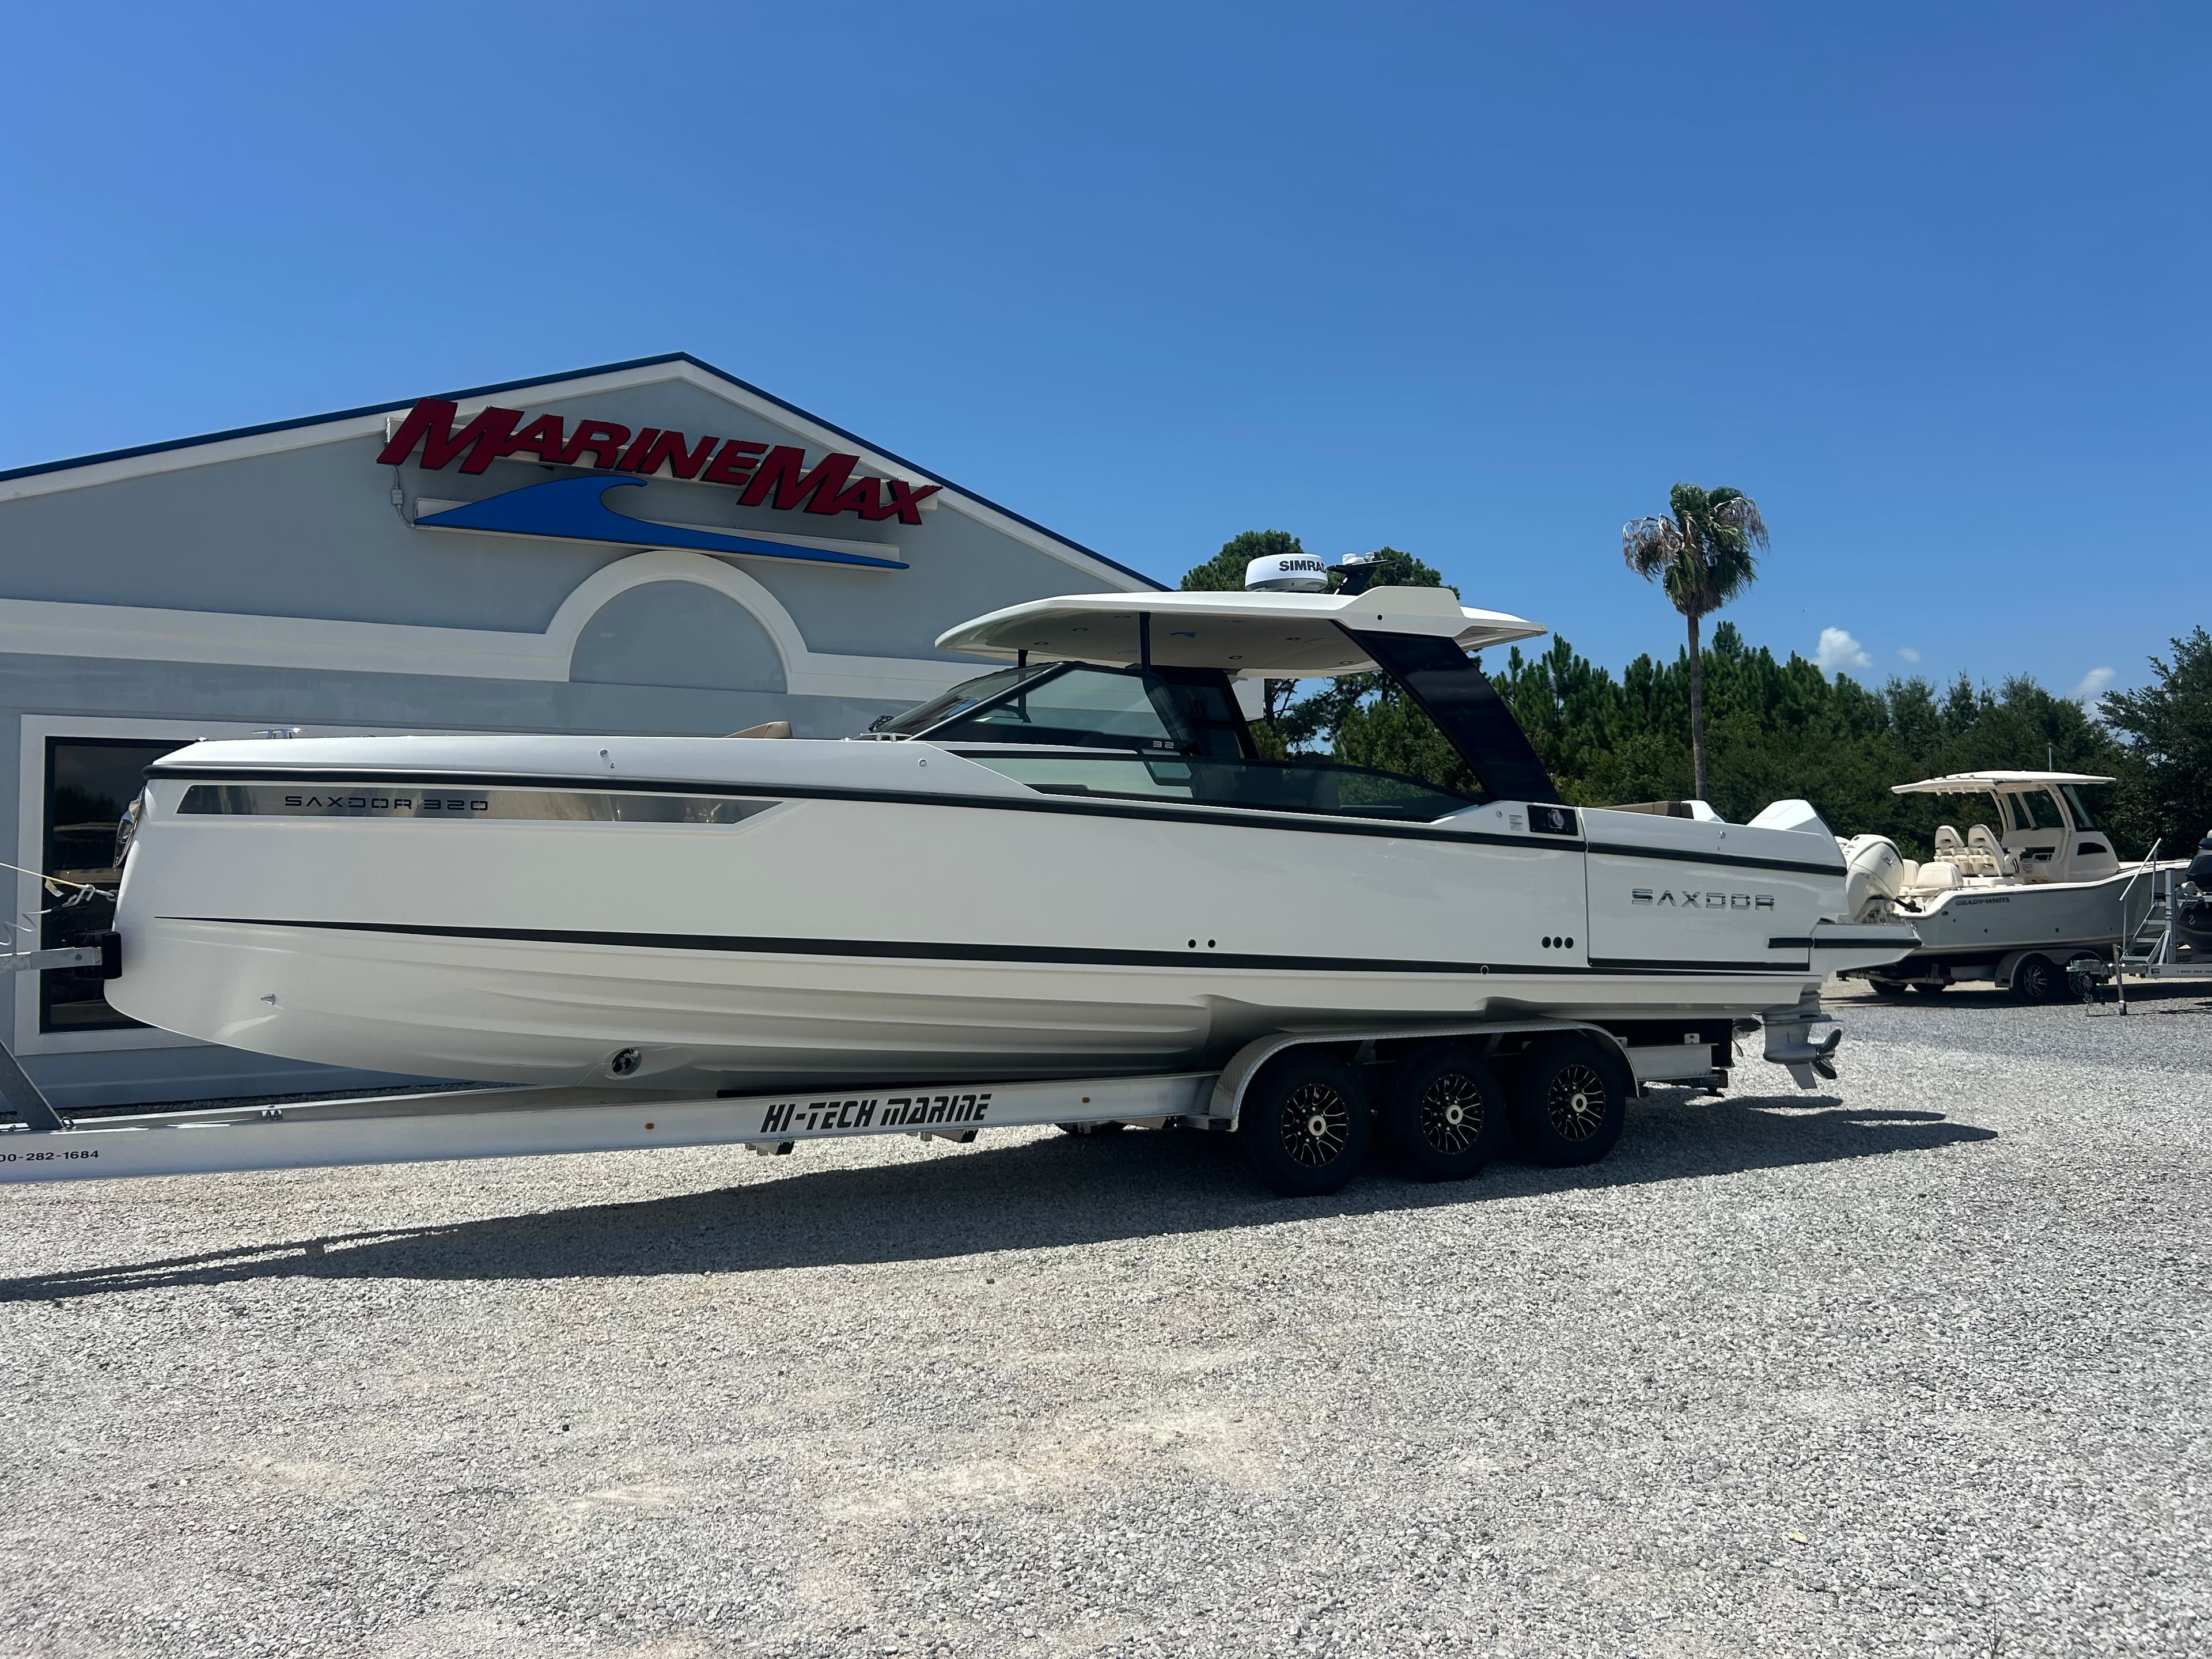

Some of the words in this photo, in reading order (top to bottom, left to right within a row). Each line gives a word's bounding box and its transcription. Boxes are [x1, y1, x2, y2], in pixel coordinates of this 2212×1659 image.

[285, 796, 412, 809] SAXDOR
[423, 799, 488, 810] 320
[1632, 888, 1775, 911] SAXDOR
[760, 1099, 878, 1133] HI-TECH
[880, 1093, 992, 1126] MARINE
